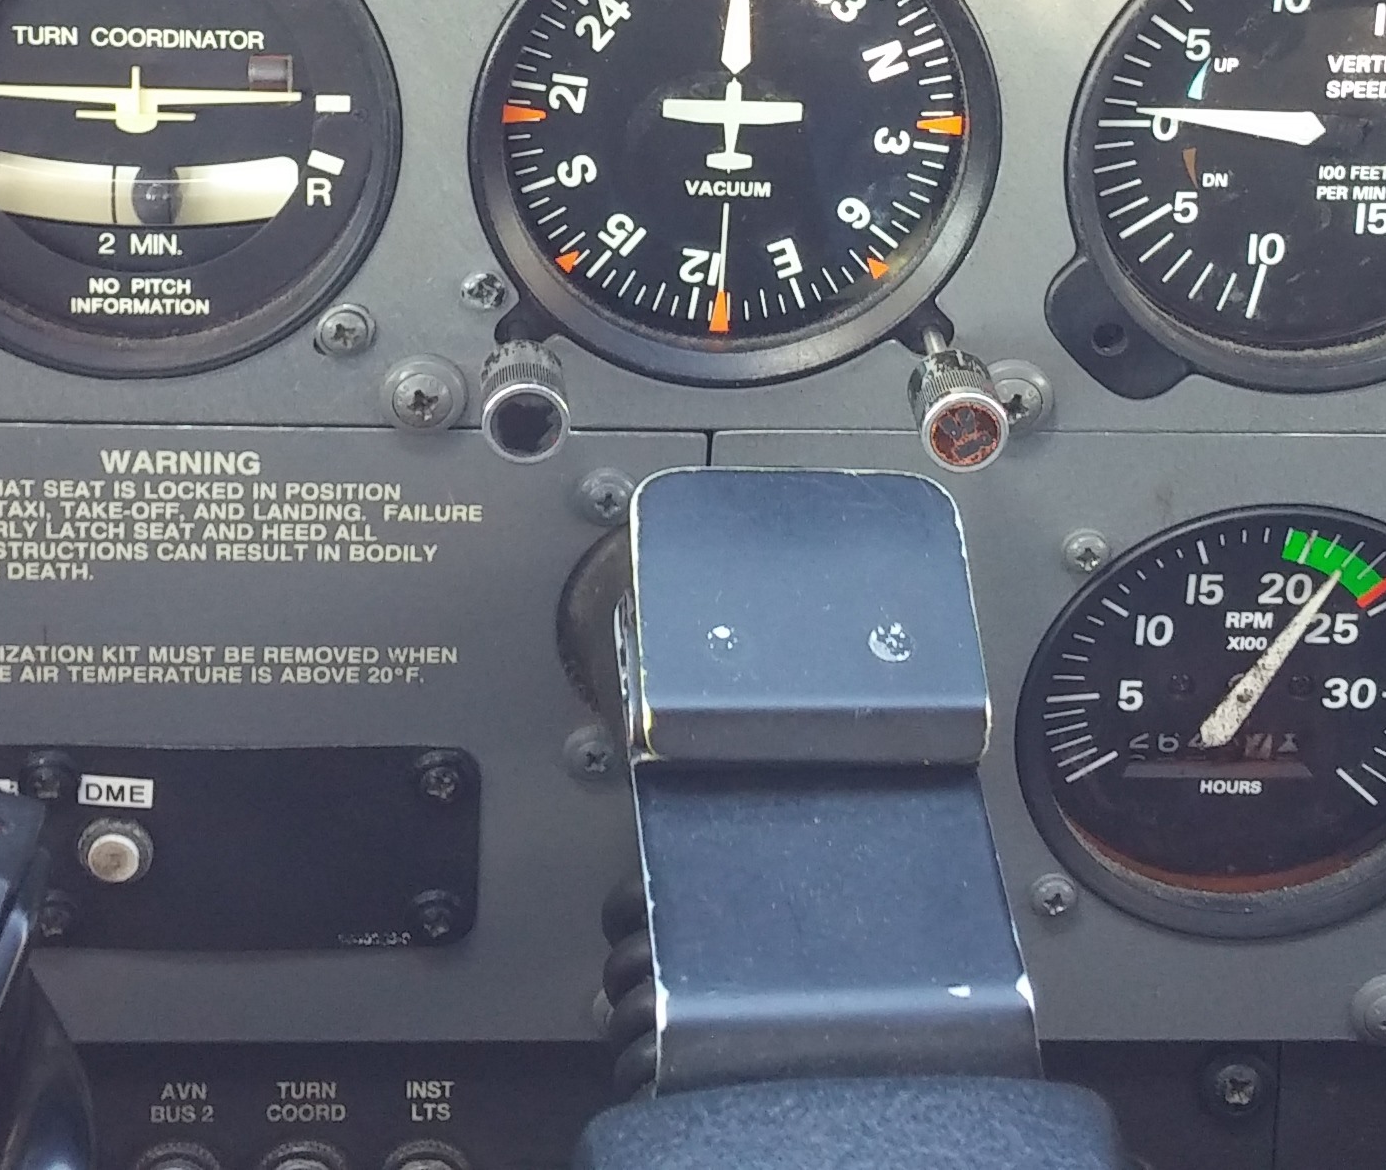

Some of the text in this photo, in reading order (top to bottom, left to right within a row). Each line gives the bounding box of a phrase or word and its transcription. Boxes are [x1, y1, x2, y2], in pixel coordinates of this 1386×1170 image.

[12, 26, 265, 51] TURN COORDINATOR
[1214, 57, 1240, 74] UP
[1202, 172, 1228, 189] DN
[1318, 165, 1346, 181] 100
[685, 180, 772, 199] VACUUM
[1317, 185, 1386, 202] PER MIN
[98, 234, 183, 257] 2 MIN.
[1248, 233, 1285, 266] 10
[89, 278, 192, 296] NO PITCH
[70, 297, 211, 317] INFORMATION
[100, 450, 261, 476] WARNING
[43, 480, 105, 498] SEAT
[113, 481, 136, 498] IS
[144, 481, 244, 499] LOCKED
[253, 482, 277, 500] IN
[285, 482, 401, 501] POSITION
[60, 501, 185, 522] TAKE-OFF,
[194, 502, 245, 520] AND
[253, 503, 366, 522] LANDING.
[384, 504, 483, 522] FAILURE
[45, 521, 125, 540] LATCH
[133, 522, 195, 541] SEAT
[202, 523, 254, 541] AND
[262, 523, 327, 541] HEED
[334, 524, 378, 542] ALL
[156, 542, 207, 562] CAN
[215, 543, 309, 562] RESULT
[316, 544, 341, 562] IN
[348, 544, 438, 563] BODILY
[7, 562, 95, 581] DEATH.
[1185, 574, 1224, 605] 15
[1258, 573, 1313, 605] 20
[1225, 612, 1273, 628] RPM
[1304, 613, 1359, 645] 25
[1135, 615, 1174, 645] 10
[1227, 637, 1267, 650] X100
[102, 645, 141, 664] KIT
[148, 645, 216, 664] MUST
[223, 646, 256, 663] BE
[263, 646, 380, 664] REMOVED
[387, 647, 458, 664] WHEN
[1322, 678, 1377, 710] 30
[84, 782, 147, 804] DME
[1200, 780, 1262, 794] HOURS
[160, 1082, 208, 1101] AVN
[276, 1081, 337, 1100] TURN
[405, 1080, 454, 1099] INST
[150, 1105, 196, 1123] BUS
[266, 1104, 347, 1122] COORD
[411, 1103, 451, 1121] LTS
